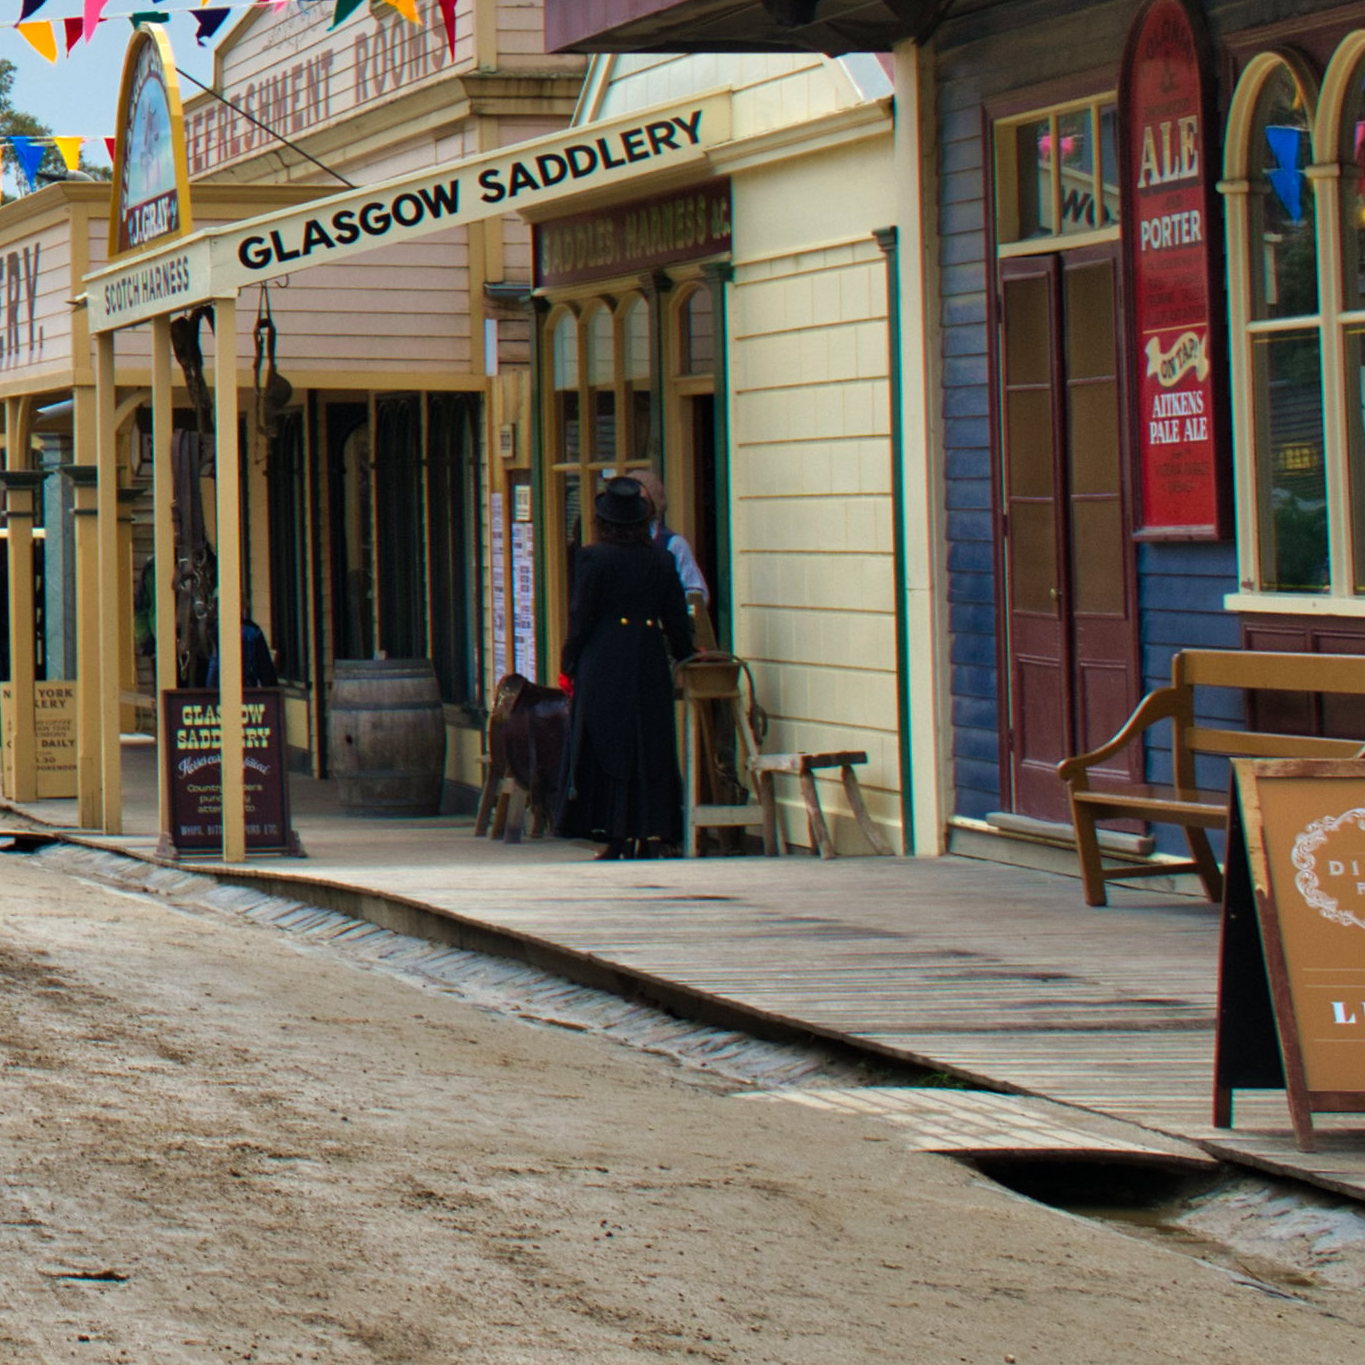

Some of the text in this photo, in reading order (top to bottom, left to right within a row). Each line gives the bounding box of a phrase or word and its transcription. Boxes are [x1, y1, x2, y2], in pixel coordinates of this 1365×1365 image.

[355, 0, 447, 105] ROOMS
[1137, 115, 1199, 188] ALE
[237, 109, 703, 270] GLASGOW SADDLERY
[1140, 209, 1202, 251] PORTER
[104, 256, 189, 315] SCOTCH HARNESS
[1152, 391, 1204, 418] AITKENS
[1149, 417, 1207, 445] PALE ALE
[38, 689, 74, 699] YORK
[42, 739, 75, 749] DAILY
